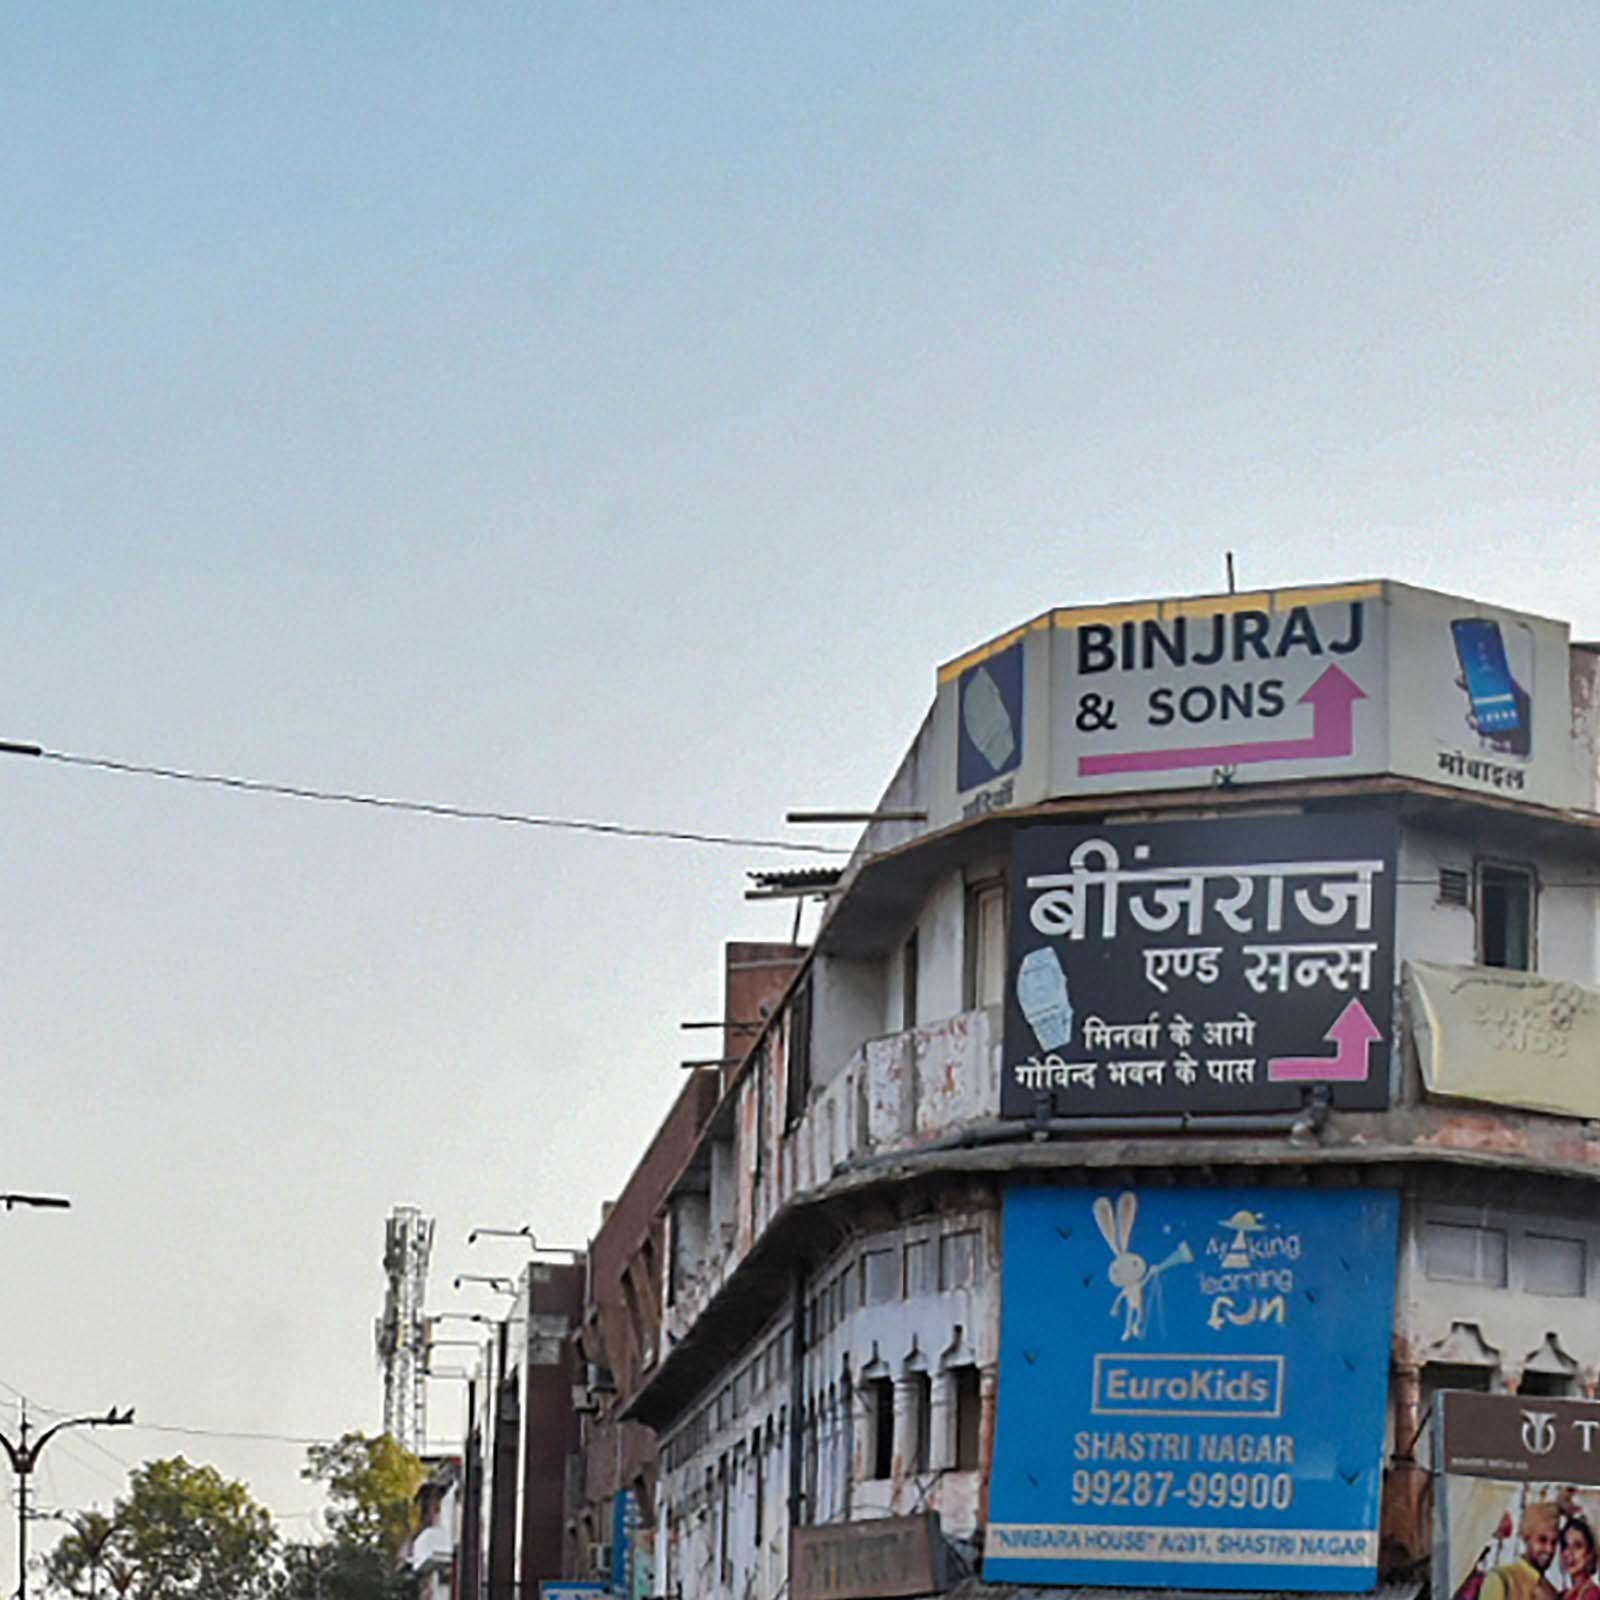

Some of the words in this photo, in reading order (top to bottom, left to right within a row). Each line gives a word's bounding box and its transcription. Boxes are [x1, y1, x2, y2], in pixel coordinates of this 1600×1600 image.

[1077, 602, 1364, 675] BINJRAJ
[1075, 692, 1118, 733] &
[1147, 680, 1285, 728] SONS
[1436, 750, 1525, 790] मोबाइल
[1142, 947, 1223, 993] एण्ड
[1243, 943, 1378, 993] सन्स
[1082, 1012, 1160, 1050] मिनर्वा
[1168, 1014, 1194, 1048] के
[1203, 1012, 1257, 1047] आगे
[1015, 1054, 1097, 1091] गोविन्द
[1108, 1058, 1165, 1086] भवन
[1174, 1053, 1199, 1086] के
[1207, 1057, 1256, 1084] पास
[1107, 1369, 1270, 1403] EuroKids
[1074, 1431, 1190, 1462] SHASTRI
[1198, 1434, 1295, 1464] NAGAR
[1072, 1470, 1293, 1510] 99287-99900
[1217, 1533, 1296, 1555] SHASTRI
[1300, 1536, 1368, 1556] NAGAR
